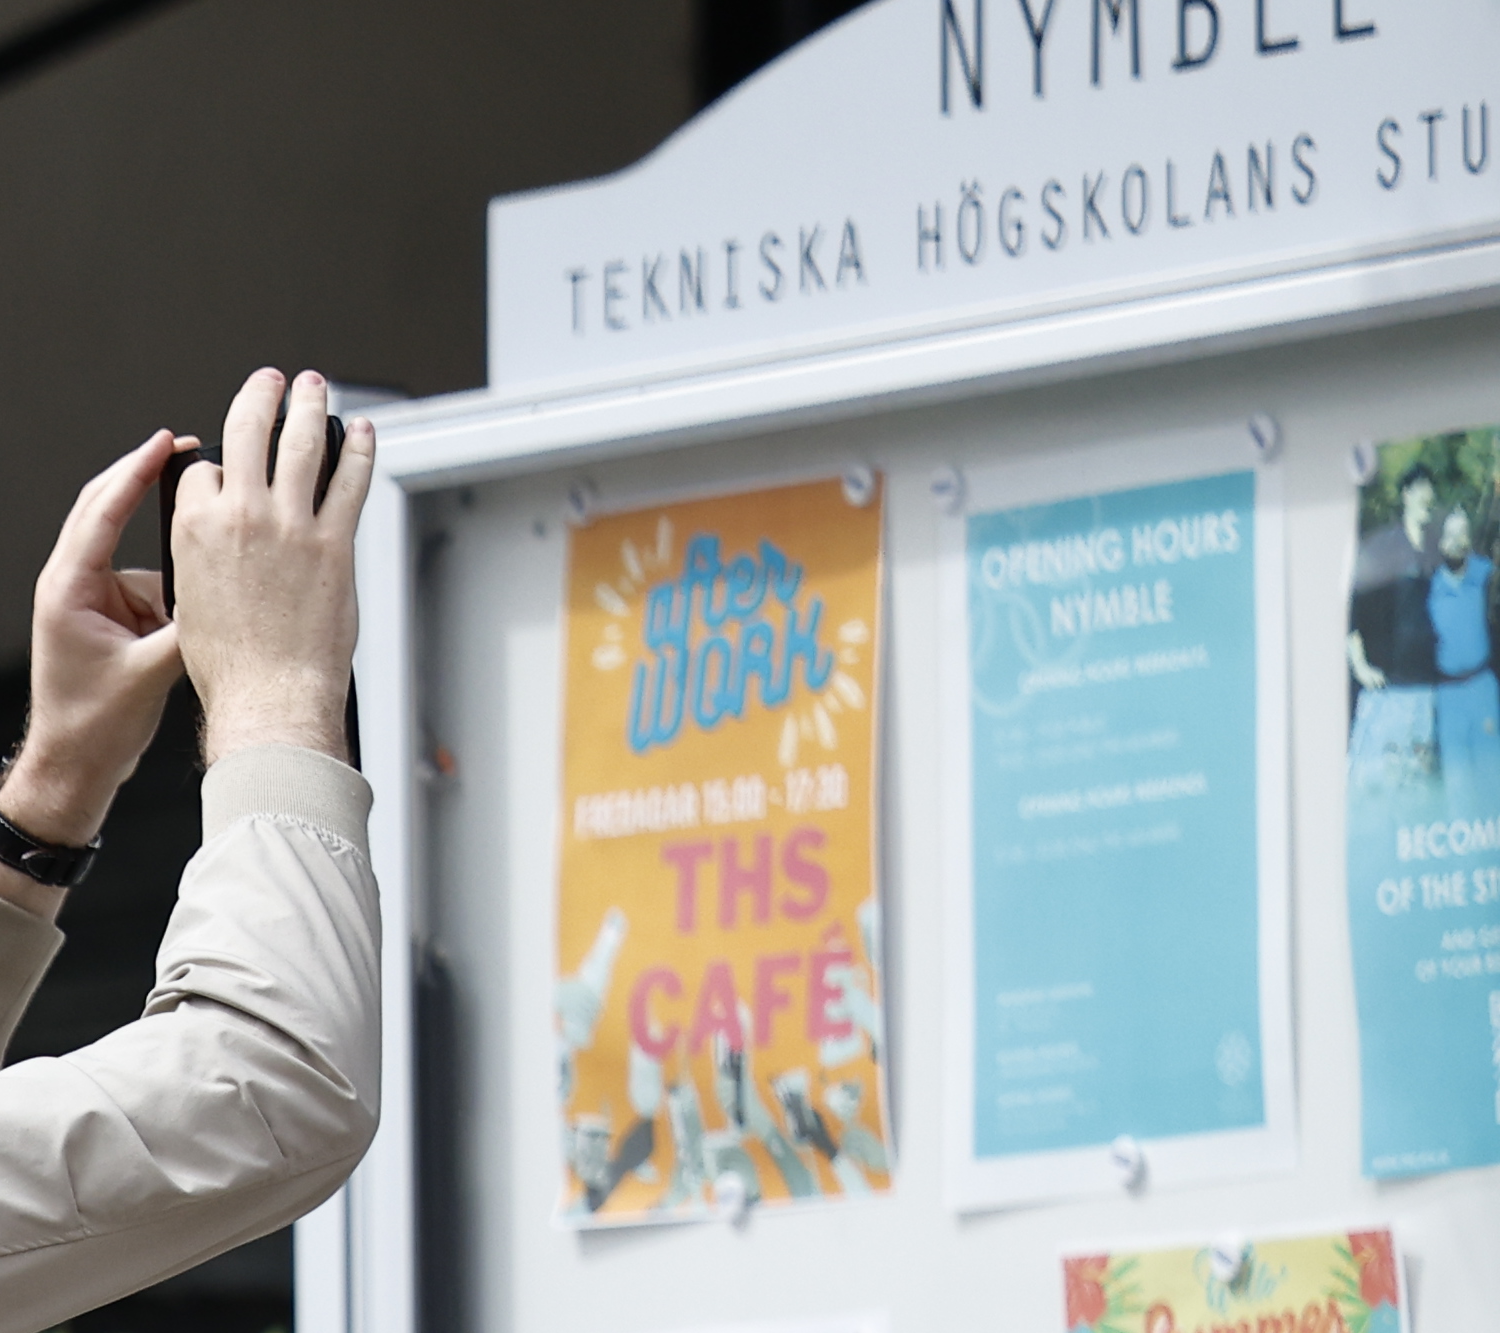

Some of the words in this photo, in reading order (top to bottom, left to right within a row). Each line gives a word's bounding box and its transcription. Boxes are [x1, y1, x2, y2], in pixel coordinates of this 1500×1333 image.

[940, 0, 1377, 116] NYMB
[565, 217, 869, 335] TEKNISKA
[916, 131, 1319, 273] HÖGSKOLANS
[1375, 101, 1490, 190] STU
[980, 529, 1124, 589] OPENING
[1131, 509, 1241, 567] HOURS
[1051, 578, 1174, 636] NYMBLE
[629, 597, 834, 755] WORK
[662, 826, 832, 936] THS
[1376, 875, 1414, 915] OF
[1419, 868, 1467, 910] THE
[1397, 818, 1500, 862] BECOM
[628, 919, 854, 1060] CAFÉ
